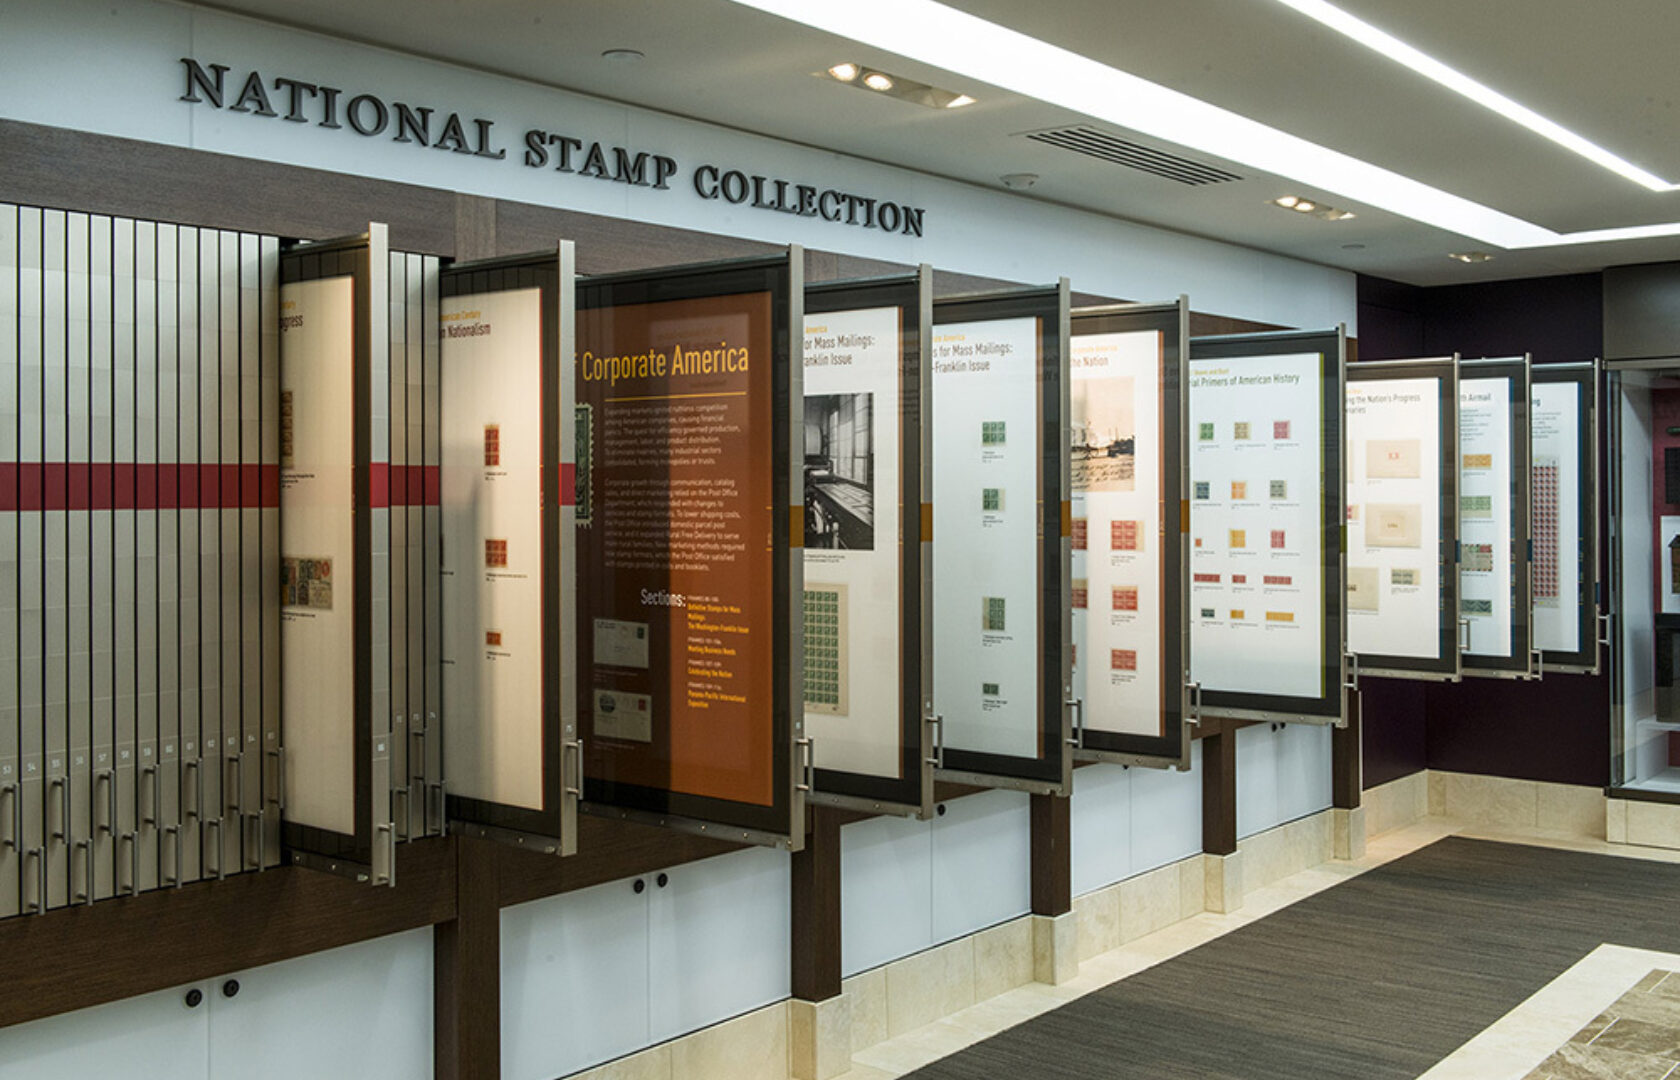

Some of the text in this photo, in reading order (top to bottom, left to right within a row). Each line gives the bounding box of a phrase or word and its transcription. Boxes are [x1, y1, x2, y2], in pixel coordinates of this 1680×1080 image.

[180, 58, 926, 238] NATIONAL STAMP COLLECTION
[447, 322, 492, 338] Nationalism
[814, 335, 836, 349] Mass
[837, 333, 877, 350] Mailings:
[939, 344, 951, 357] for
[952, 343, 974, 356] Mass
[975, 342, 1014, 357] Mailings:
[582, 341, 749, 387] Corporate America
[830, 352, 853, 366] Issue
[968, 360, 991, 372] Issue
[1082, 355, 1109, 368] Nation
[1201, 376, 1229, 387] Primers
[1230, 375, 1237, 385] of
[1239, 374, 1272, 385] American
[1273, 373, 1300, 385] History
[1393, 393, 1421, 404] Progress
[640, 588, 687, 608] Sections:
